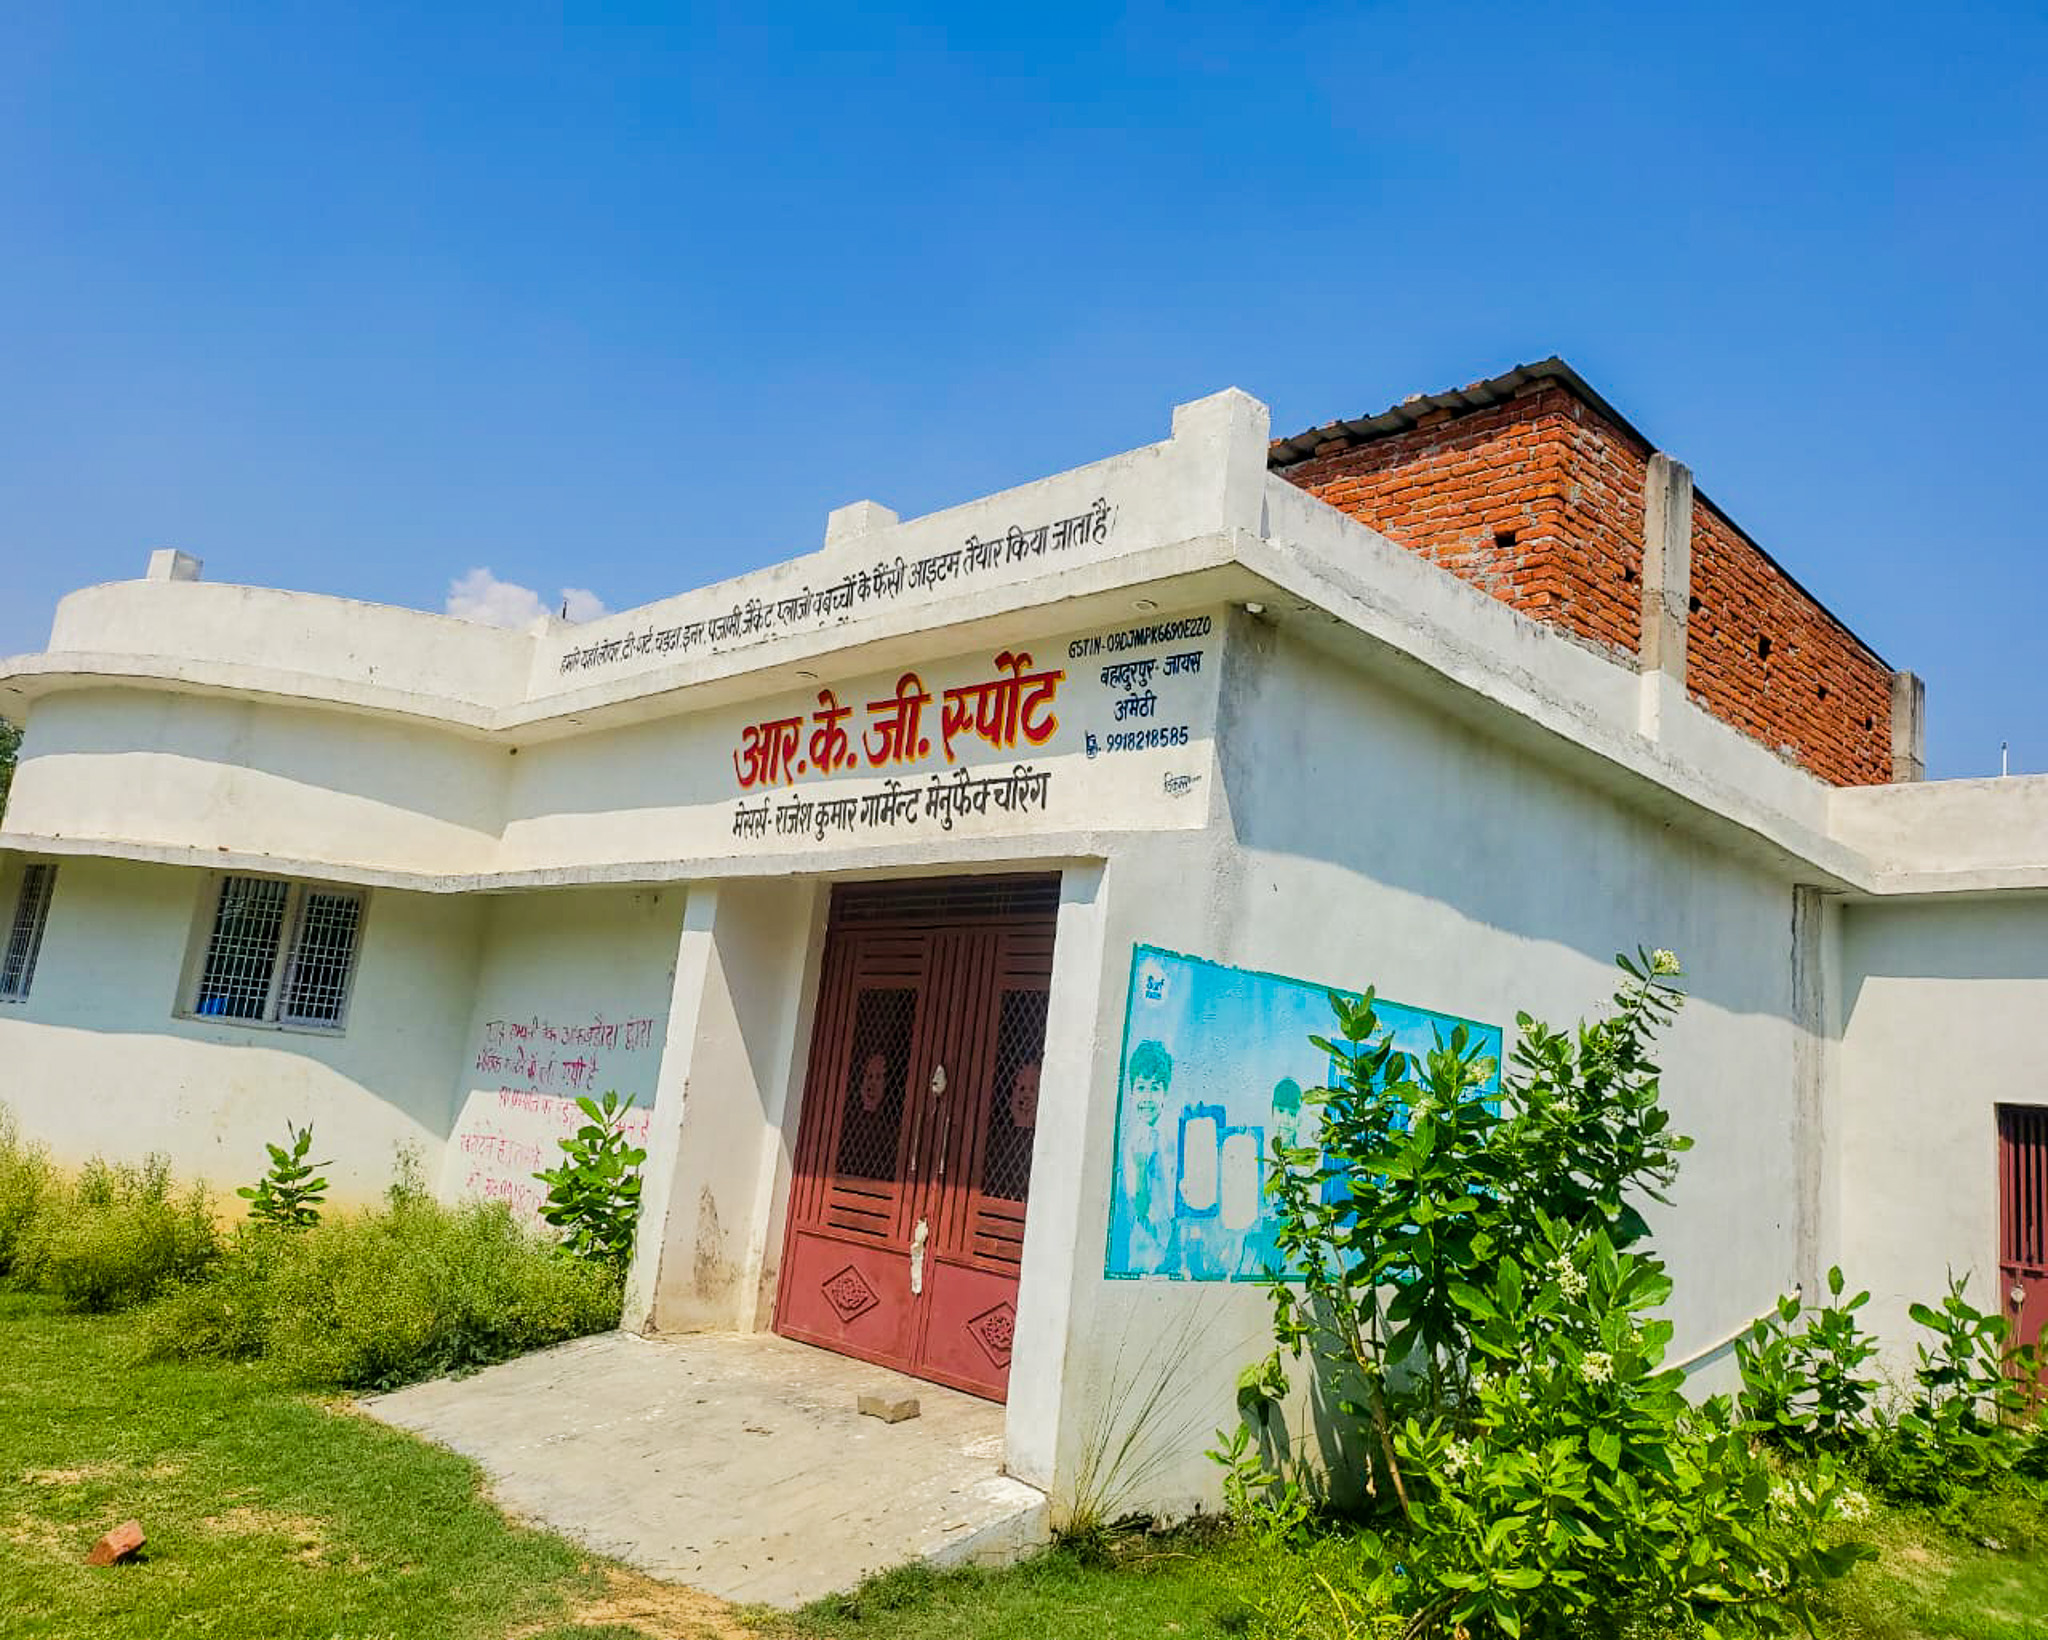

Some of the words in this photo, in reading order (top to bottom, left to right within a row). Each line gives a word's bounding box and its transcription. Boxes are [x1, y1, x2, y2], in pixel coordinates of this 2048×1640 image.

[857, 570, 871, 602] के
[908, 549, 962, 591] आइटम
[963, 535, 1004, 577] तैयार
[1006, 525, 1050, 563] किया
[1050, 512, 1094, 551] जाता
[1162, 650, 1204, 677] जायस
[1114, 689, 1157, 721] अमेठी
[1106, 726, 1189, 753] 9918218585
[775, 793, 815, 836] राजेश
[815, 797, 858, 842] कुमार
